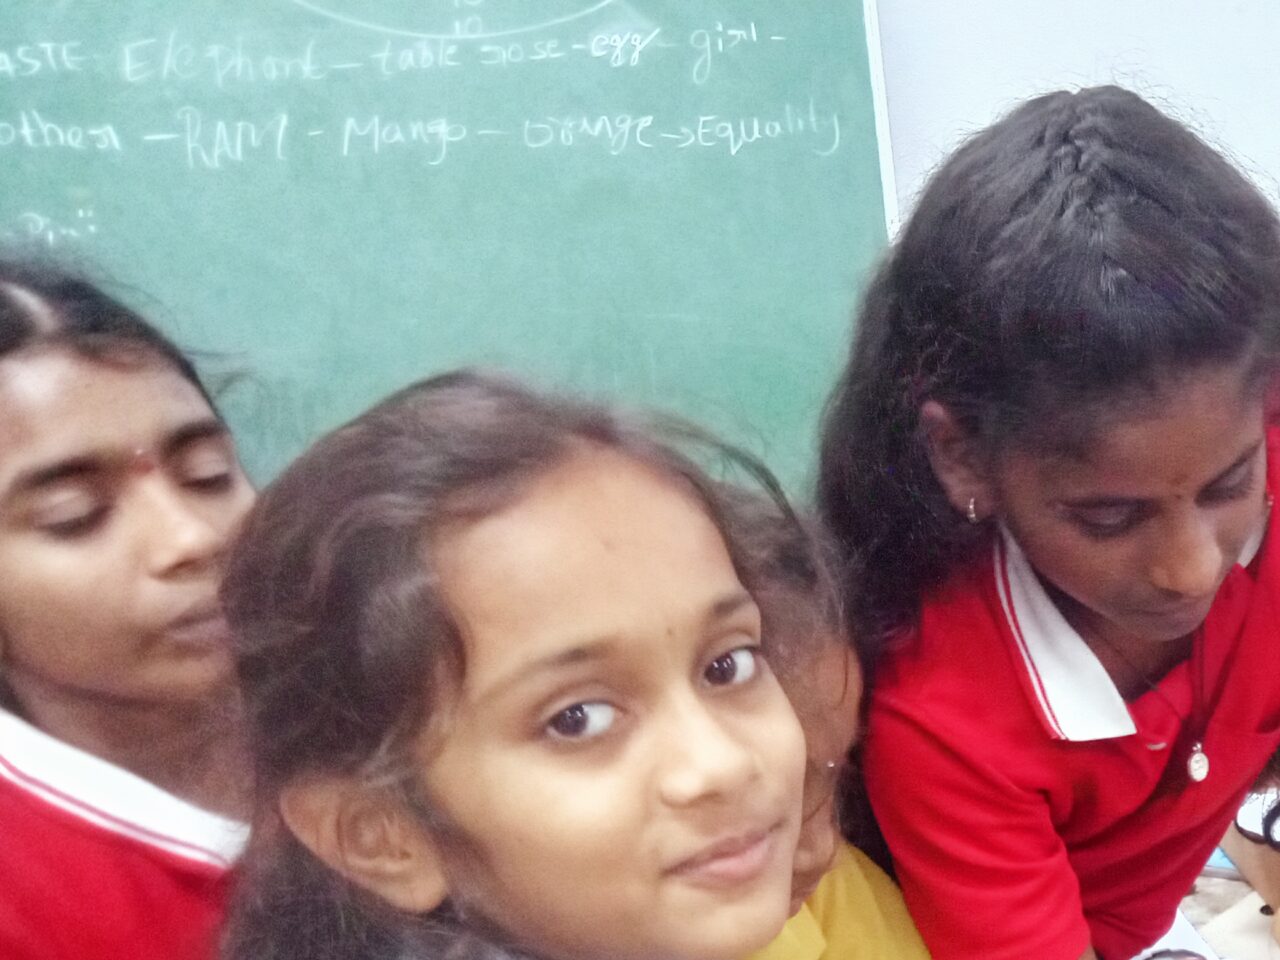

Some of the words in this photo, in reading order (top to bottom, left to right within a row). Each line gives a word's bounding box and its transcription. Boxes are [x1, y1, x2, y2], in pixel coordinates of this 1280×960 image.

[121, 30, 327, 88] Elephant
[343, 115, 466, 165] Mango
[698, 98, 840, 156] Equality
